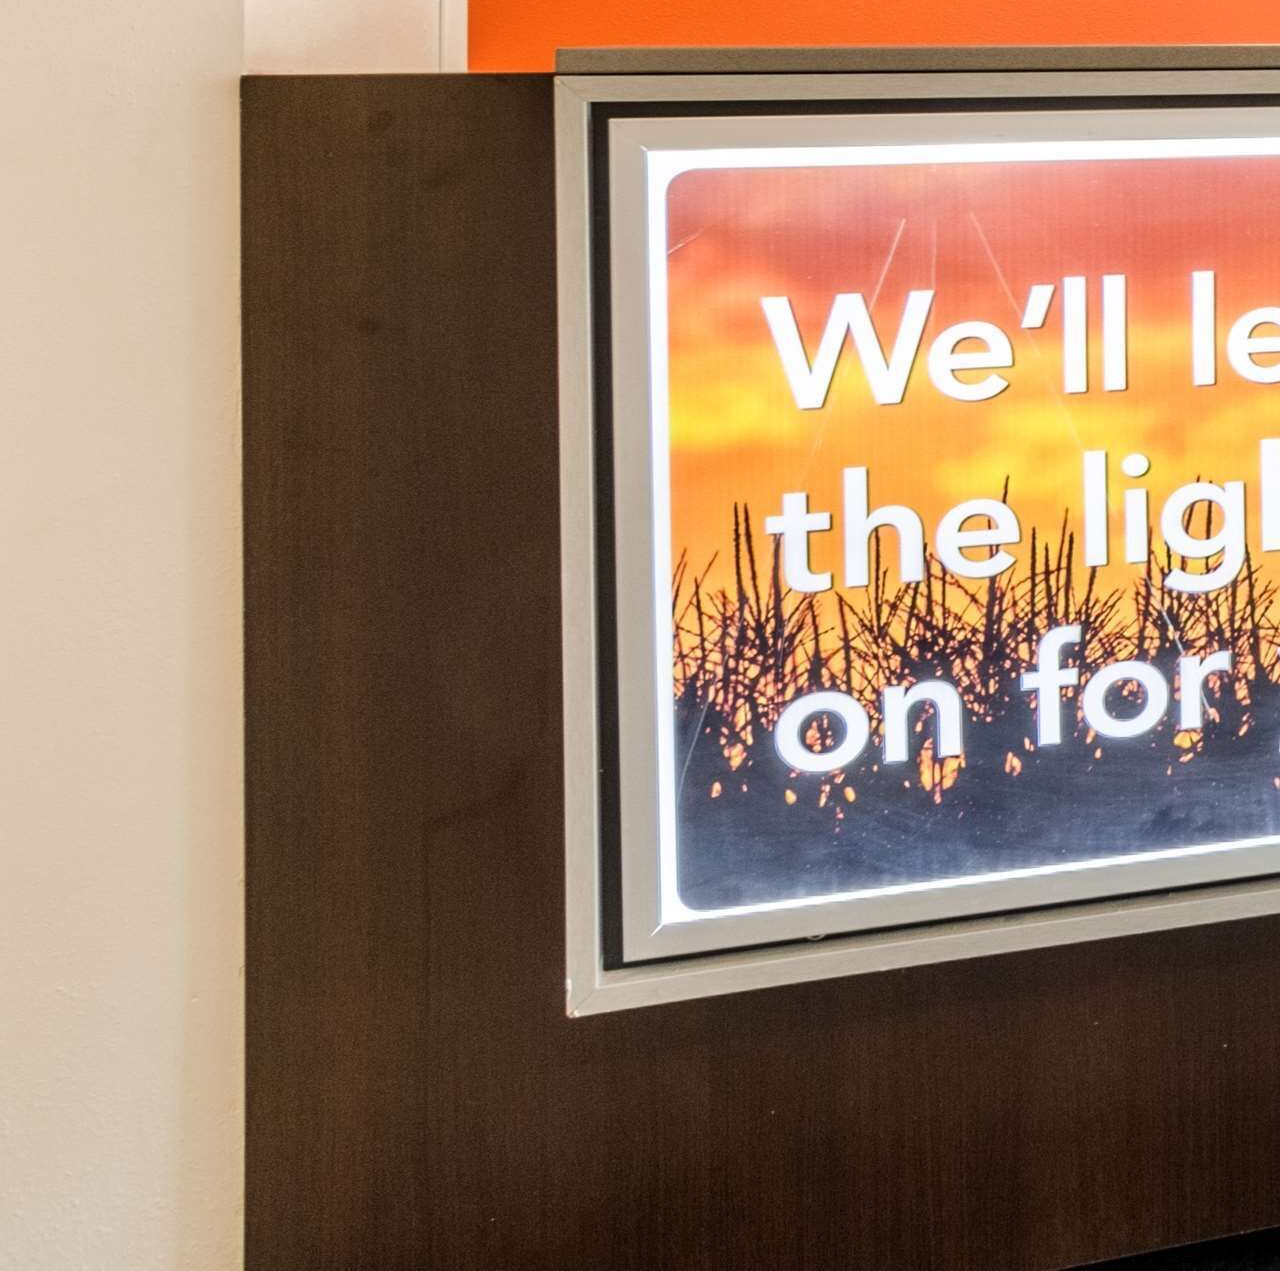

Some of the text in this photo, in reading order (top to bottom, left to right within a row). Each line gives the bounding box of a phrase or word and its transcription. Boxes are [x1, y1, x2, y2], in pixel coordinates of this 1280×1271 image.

[761, 274, 1128, 409] We’ll
[765, 466, 1020, 594] the
[774, 676, 967, 774] on
[1021, 624, 1232, 747] for
